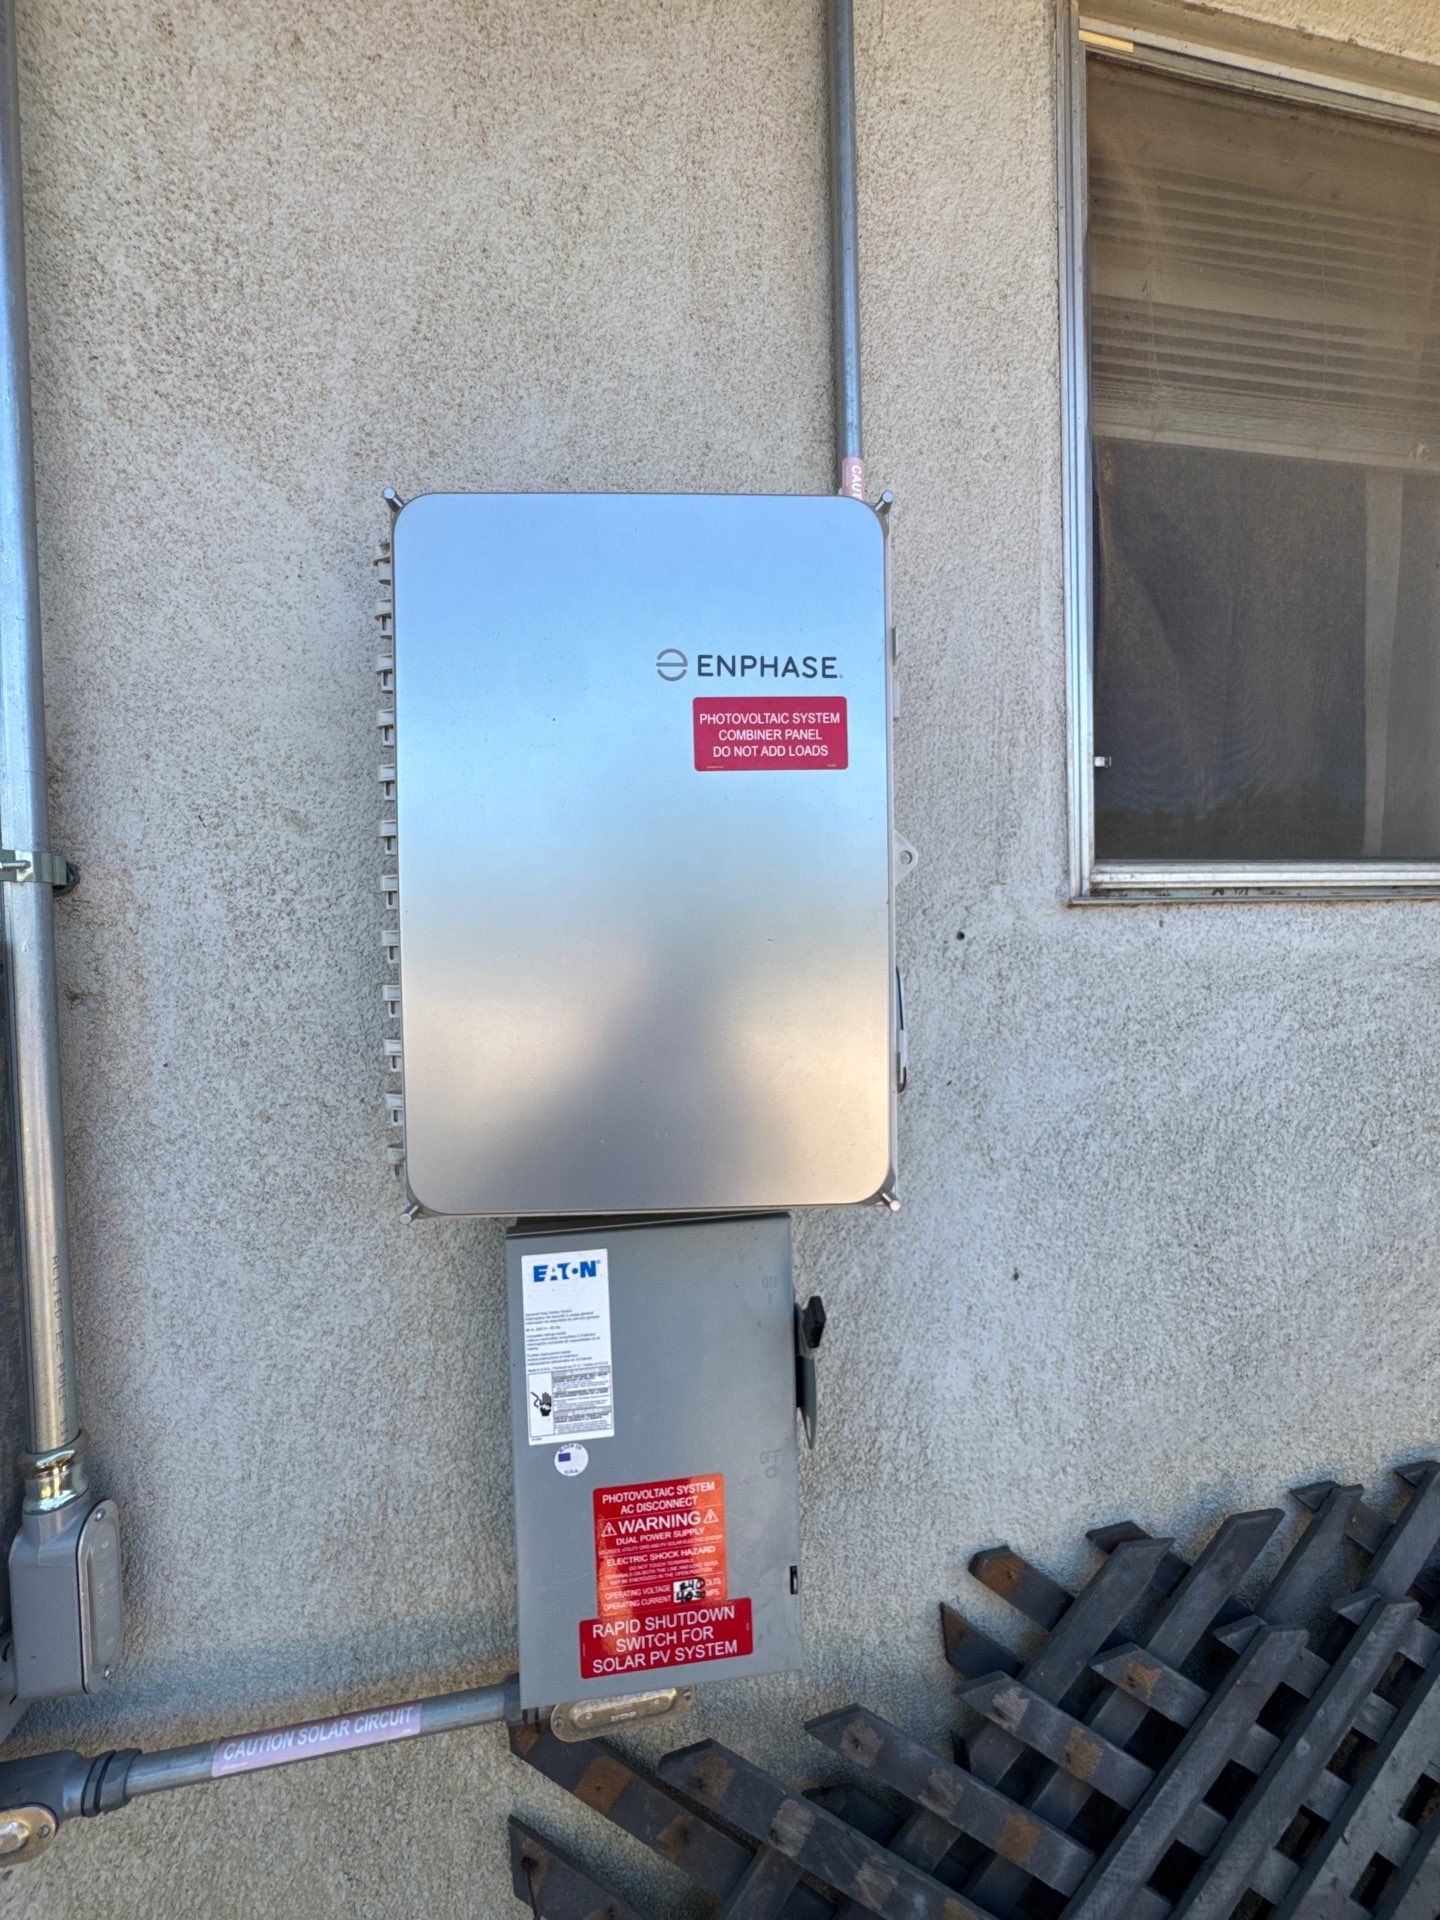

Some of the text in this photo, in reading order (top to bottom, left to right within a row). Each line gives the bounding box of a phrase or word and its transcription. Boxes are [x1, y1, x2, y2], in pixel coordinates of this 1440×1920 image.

[698, 654, 838, 679] ENPHASE
[700, 712, 840, 725] PHOTOVOLTAIC SYSTEM
[718, 729, 822, 741] COMBINER PANEL
[713, 745, 828, 758] DO NOT ADD LOADS
[533, 1260, 596, 1282] EATON
[602, 1481, 715, 1504] PHOTOVOLTAIC SYSTEM
[620, 1496, 697, 1515] AC DISCONNECT
[618, 1511, 701, 1534] WARNING
[616, 1527, 704, 1546] DUAL POWER SUPPLY
[607, 1546, 716, 1566] ELECTRIC SHOCK HAZARD
[605, 1589, 641, 1600] OPERATING
[643, 1584, 671, 1594] VOLTAGE
[705, 1578, 721, 1586] OLTS
[604, 1600, 640, 1611] OPERATING
[641, 1595, 671, 1605] CURRENT
[592, 1619, 640, 1638] RAPID
[644, 1606, 735, 1631] SHUTDOWN
[616, 1626, 714, 1653] SWITCH FOR
[592, 1640, 737, 1674] SOLAR PV SYSTEM
[224, 1706, 414, 1761] CAUTION SOLAR CIRCUIT
